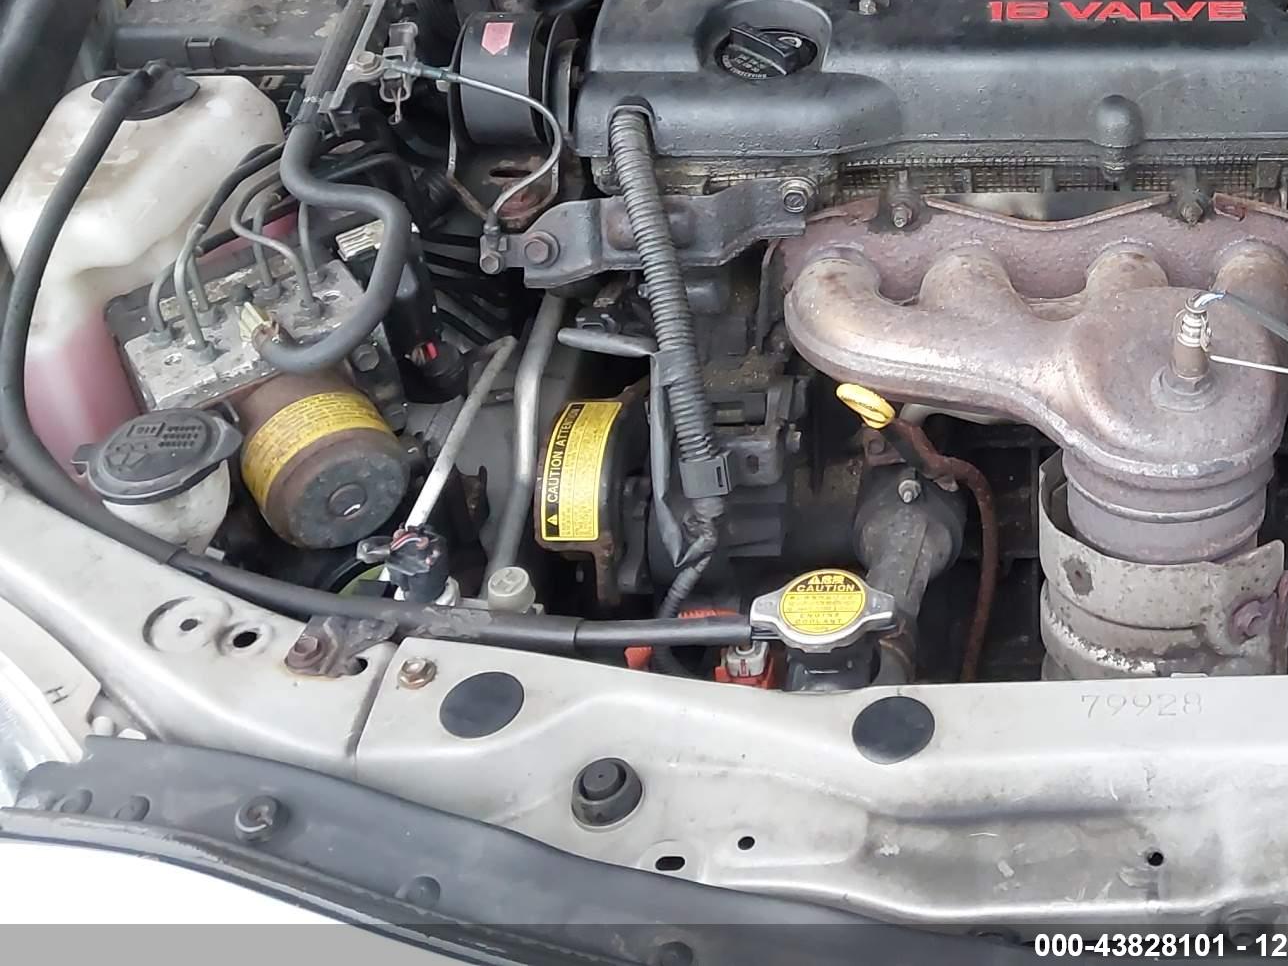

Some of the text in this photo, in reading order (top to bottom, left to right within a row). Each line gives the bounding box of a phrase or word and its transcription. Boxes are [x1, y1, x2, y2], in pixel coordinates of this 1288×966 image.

[988, 0, 1248, 22] 16 VALVE
[547, 450, 564, 503] CAUTION
[797, 584, 855, 592] CAUTION
